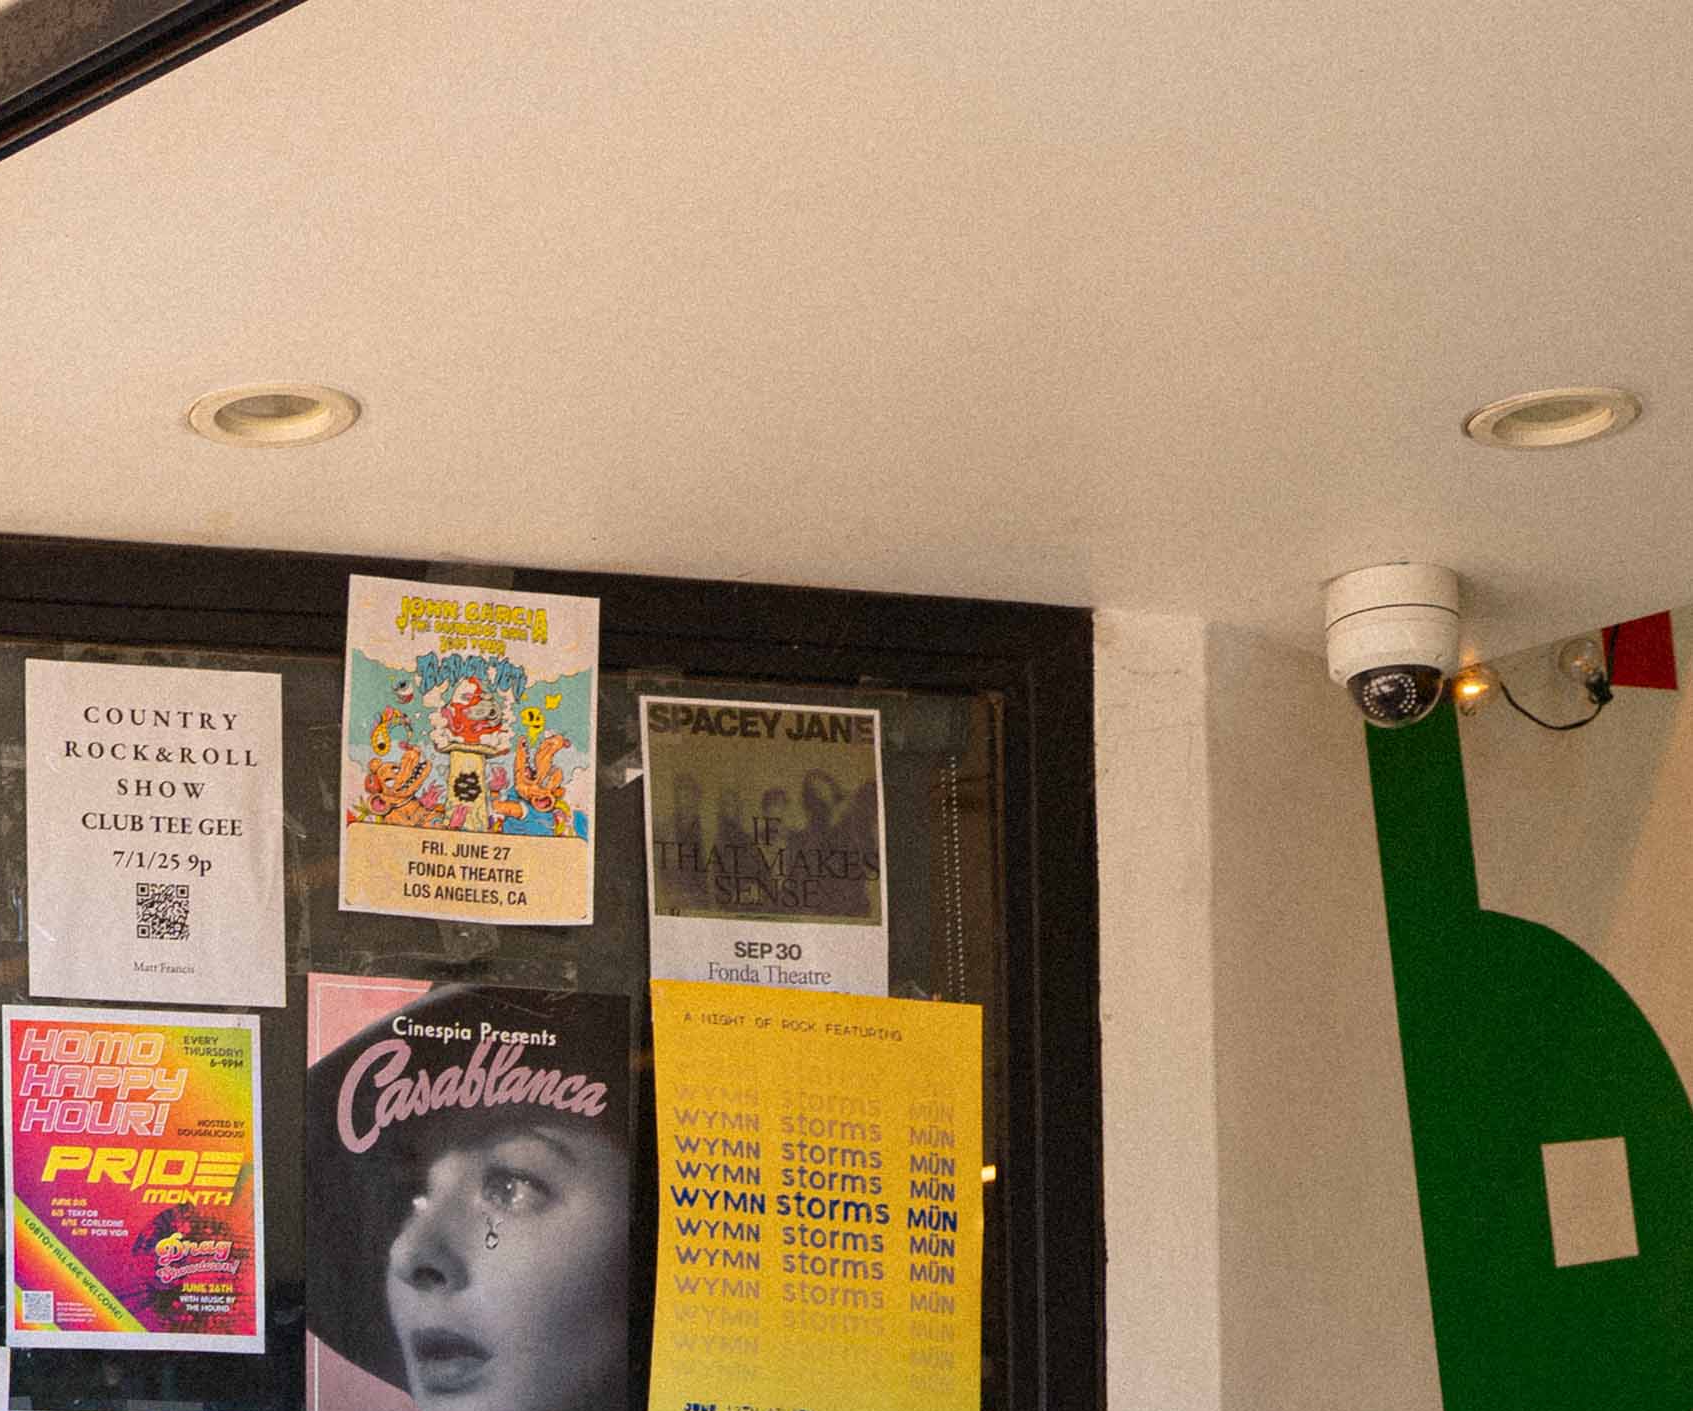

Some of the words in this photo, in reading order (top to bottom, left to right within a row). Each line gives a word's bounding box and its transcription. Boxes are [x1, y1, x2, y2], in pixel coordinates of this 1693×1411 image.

[395, 596, 459, 634] JOHN
[464, 600, 548, 645] GARCIA
[83, 705, 239, 731] COUNTRY
[647, 704, 782, 739] SPACEY
[786, 711, 874, 746] JANE
[64, 740, 259, 768] ROCK&ROLL
[116, 778, 206, 800] SHOW
[81, 811, 145, 834] CLUB
[150, 815, 193, 835] TEE
[198, 817, 243, 838] GEE
[112, 849, 181, 872] 7/1/25
[187, 853, 213, 877] 9p
[421, 840, 447, 856] FRI.
[452, 843, 489, 860] JUNE
[493, 847, 511, 860] 27
[408, 861, 456, 879] FONDA
[459, 865, 524, 884] THEATRE
[403, 883, 431, 898] LOS
[434, 885, 503, 906] ANGELES,
[507, 891, 527, 905] CA
[734, 941, 772, 959] SEP
[776, 943, 802, 960] 30
[133, 961, 157, 974] Matt
[707, 962, 759, 982] Fonda
[763, 965, 832, 985] Theatre
[184, 1035, 218, 1046] EVERY
[392, 1016, 471, 1044] Cinespia
[480, 1022, 556, 1046] Presents
[683, 1012, 692, 1023] A
[701, 1014, 746, 1026] NIGHT
[756, 1017, 772, 1028] OF
[781, 1018, 816, 1033] ROCK
[825, 1024, 903, 1041] FEATURING
[19, 1028, 167, 1065] HOMO
[19, 1064, 188, 1101] HAPPY
[337, 1035, 608, 1154] Casablanca
[20, 1098, 169, 1137] HOUR!
[41, 1146, 244, 1192] PRIDE
[142, 1188, 234, 1207] MONTH
[670, 1186, 765, 1215] WYMN
[776, 1194, 890, 1225] storms
[907, 1207, 957, 1233] MÜN
